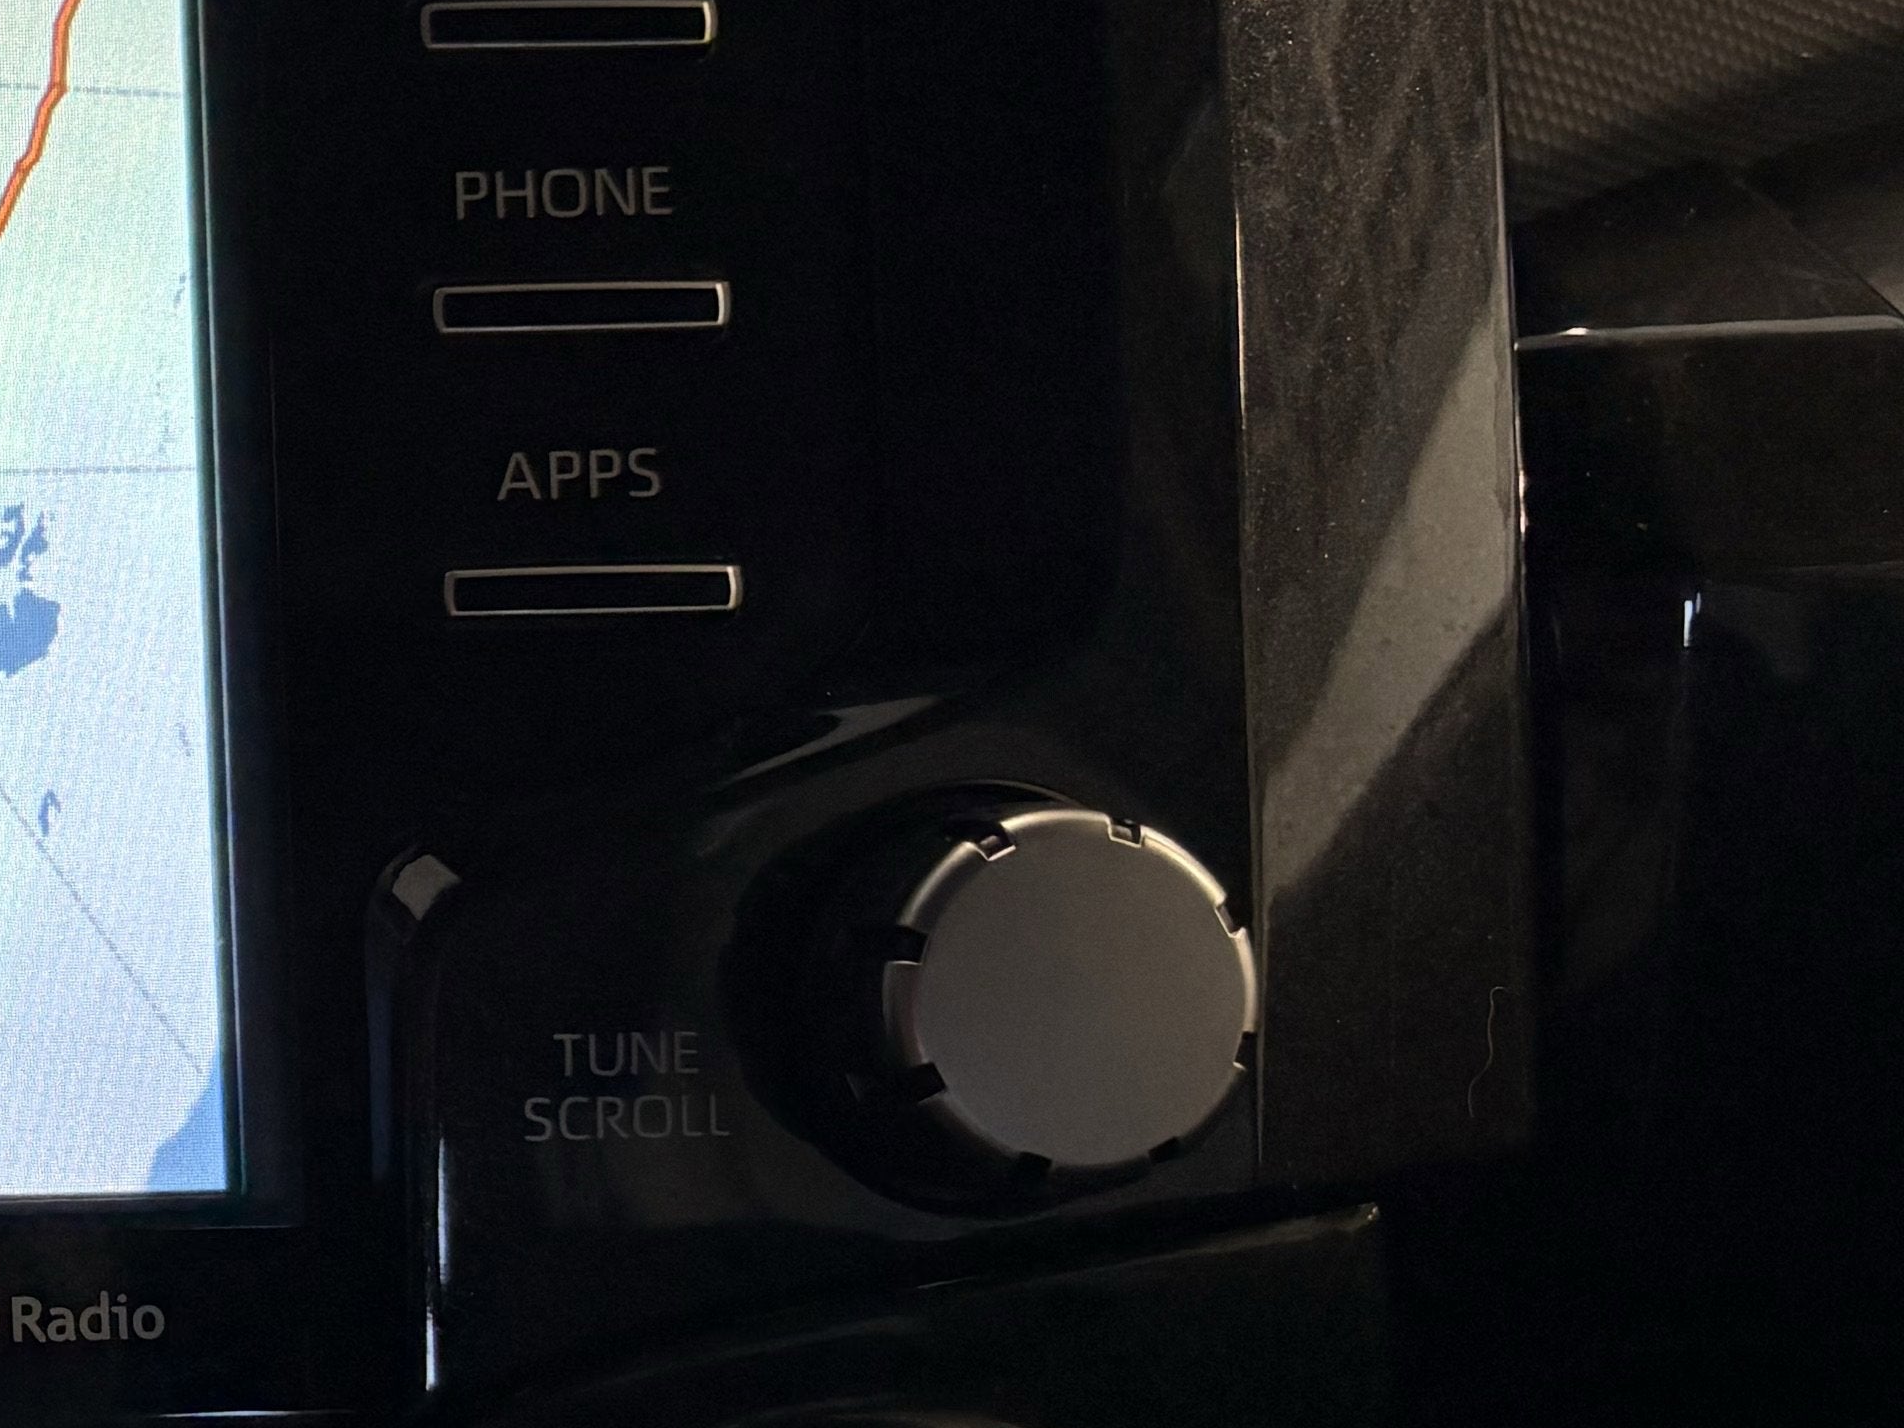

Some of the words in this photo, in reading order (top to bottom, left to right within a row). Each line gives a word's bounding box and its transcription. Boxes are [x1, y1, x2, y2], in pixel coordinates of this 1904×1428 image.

[454, 165, 674, 221] PHONE
[495, 446, 663, 501] APPS
[552, 1030, 700, 1078] TUNE
[522, 1091, 731, 1143] SCROLL
[11, 1292, 166, 1343] Radio
